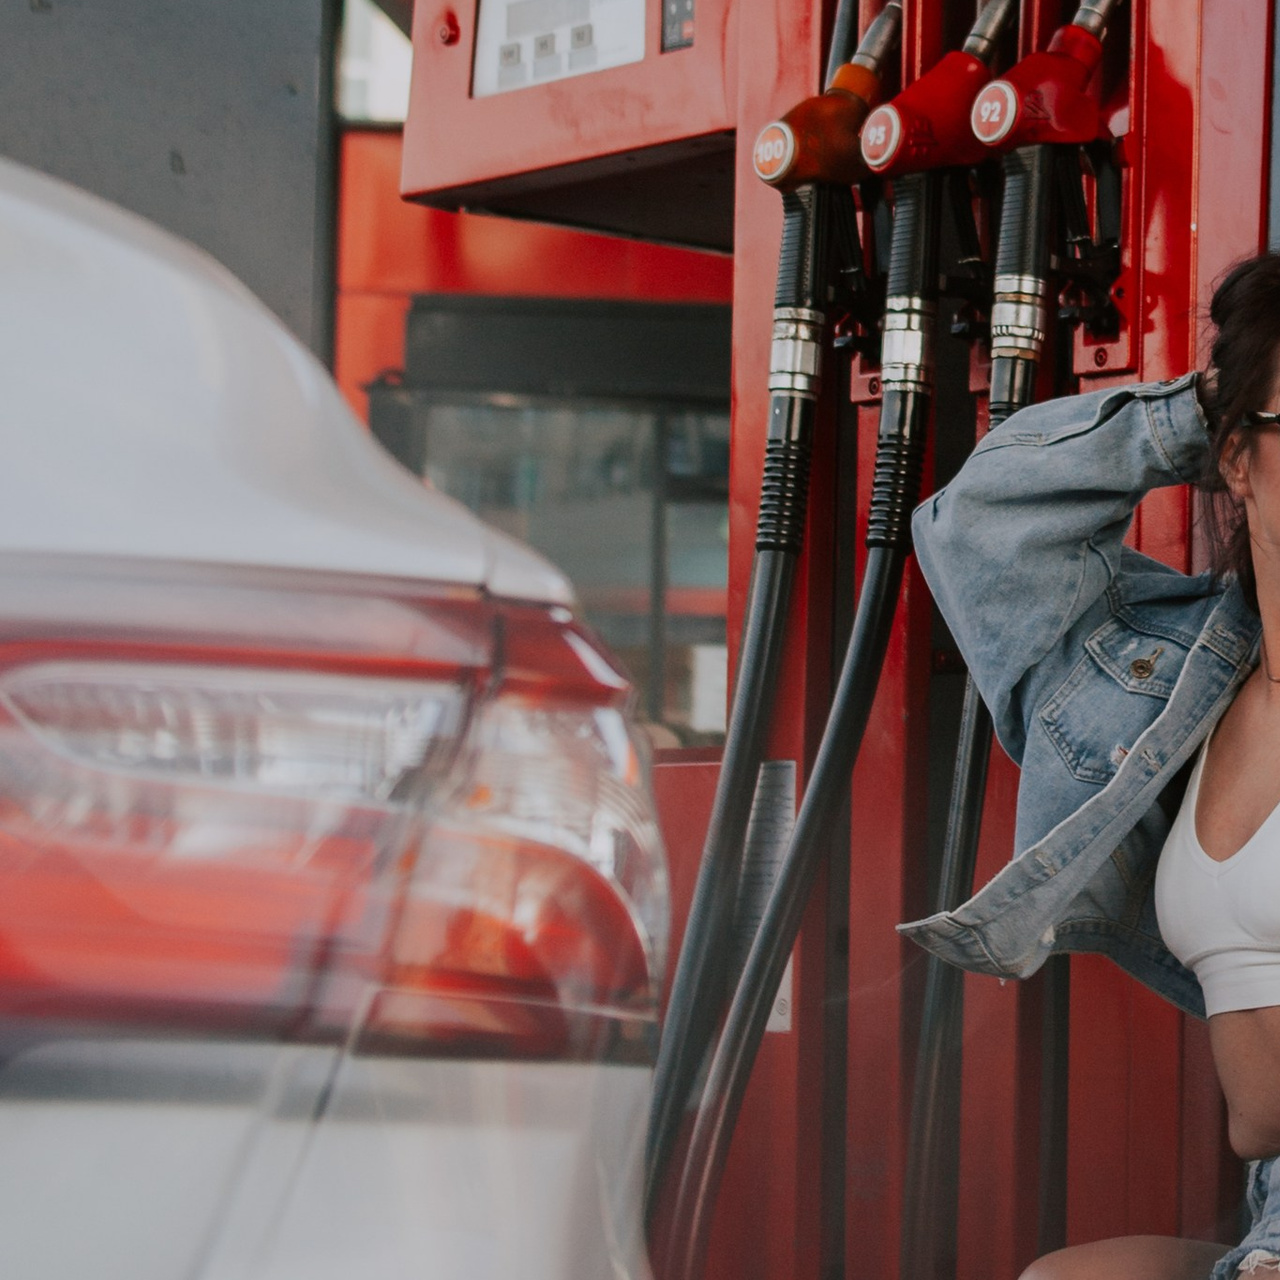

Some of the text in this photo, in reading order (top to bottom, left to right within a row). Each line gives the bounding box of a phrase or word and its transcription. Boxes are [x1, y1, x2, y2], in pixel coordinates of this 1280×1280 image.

[980, 101, 1001, 122] 92
[867, 125, 887, 146] 95
[757, 139, 784, 163] 100
